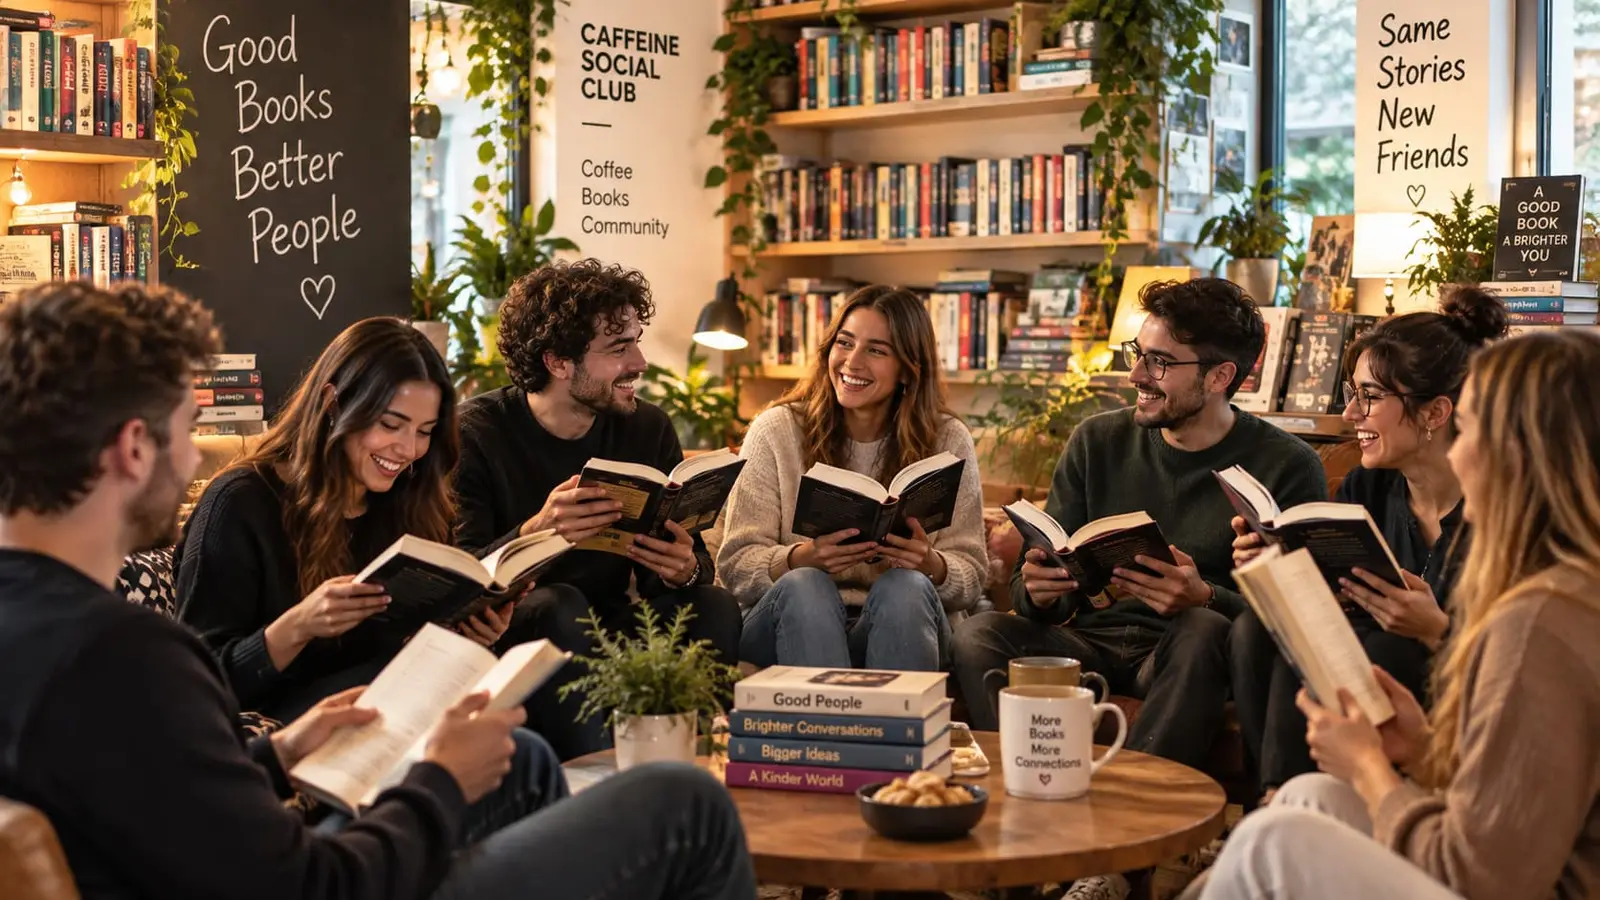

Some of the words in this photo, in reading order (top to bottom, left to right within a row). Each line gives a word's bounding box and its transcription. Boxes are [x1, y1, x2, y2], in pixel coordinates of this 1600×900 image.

[580, 22, 680, 57] CAFFEINE
[1378, 12, 1451, 48] Same
[202, 14, 298, 76] Good
[581, 49, 661, 80] SOCIAL
[1376, 54, 1466, 90] Stories
[581, 77, 636, 103] CLUB
[234, 73, 334, 135] Books
[1377, 97, 1436, 132] New
[1377, 133, 1469, 174] Friends
[230, 139, 344, 201] Better
[581, 158, 633, 180] Coffee
[581, 187, 630, 207] Books
[1533, 185, 1544, 198] A
[1517, 201, 1561, 214] GOOD
[247, 193, 361, 265] People
[581, 215, 670, 240] Community
[1516, 216, 1560, 230] BOOK
[1502, 235, 1511, 246] A
[1514, 234, 1568, 246] BRIGHTER
[1520, 249, 1550, 262] YOU
[773, 692, 811, 707] Good
[815, 694, 863, 711] People
[743, 718, 794, 735] Brighter
[796, 720, 884, 737] Conversations
[1031, 714, 1062, 726] More
[1029, 727, 1065, 740] Books
[761, 745, 803, 761] Bigger
[1031, 743, 1061, 756] More
[1015, 756, 1082, 769] Connections
[748, 769, 758, 782] A
[761, 770, 803, 785] Kinder
[805, 772, 844, 787] World
